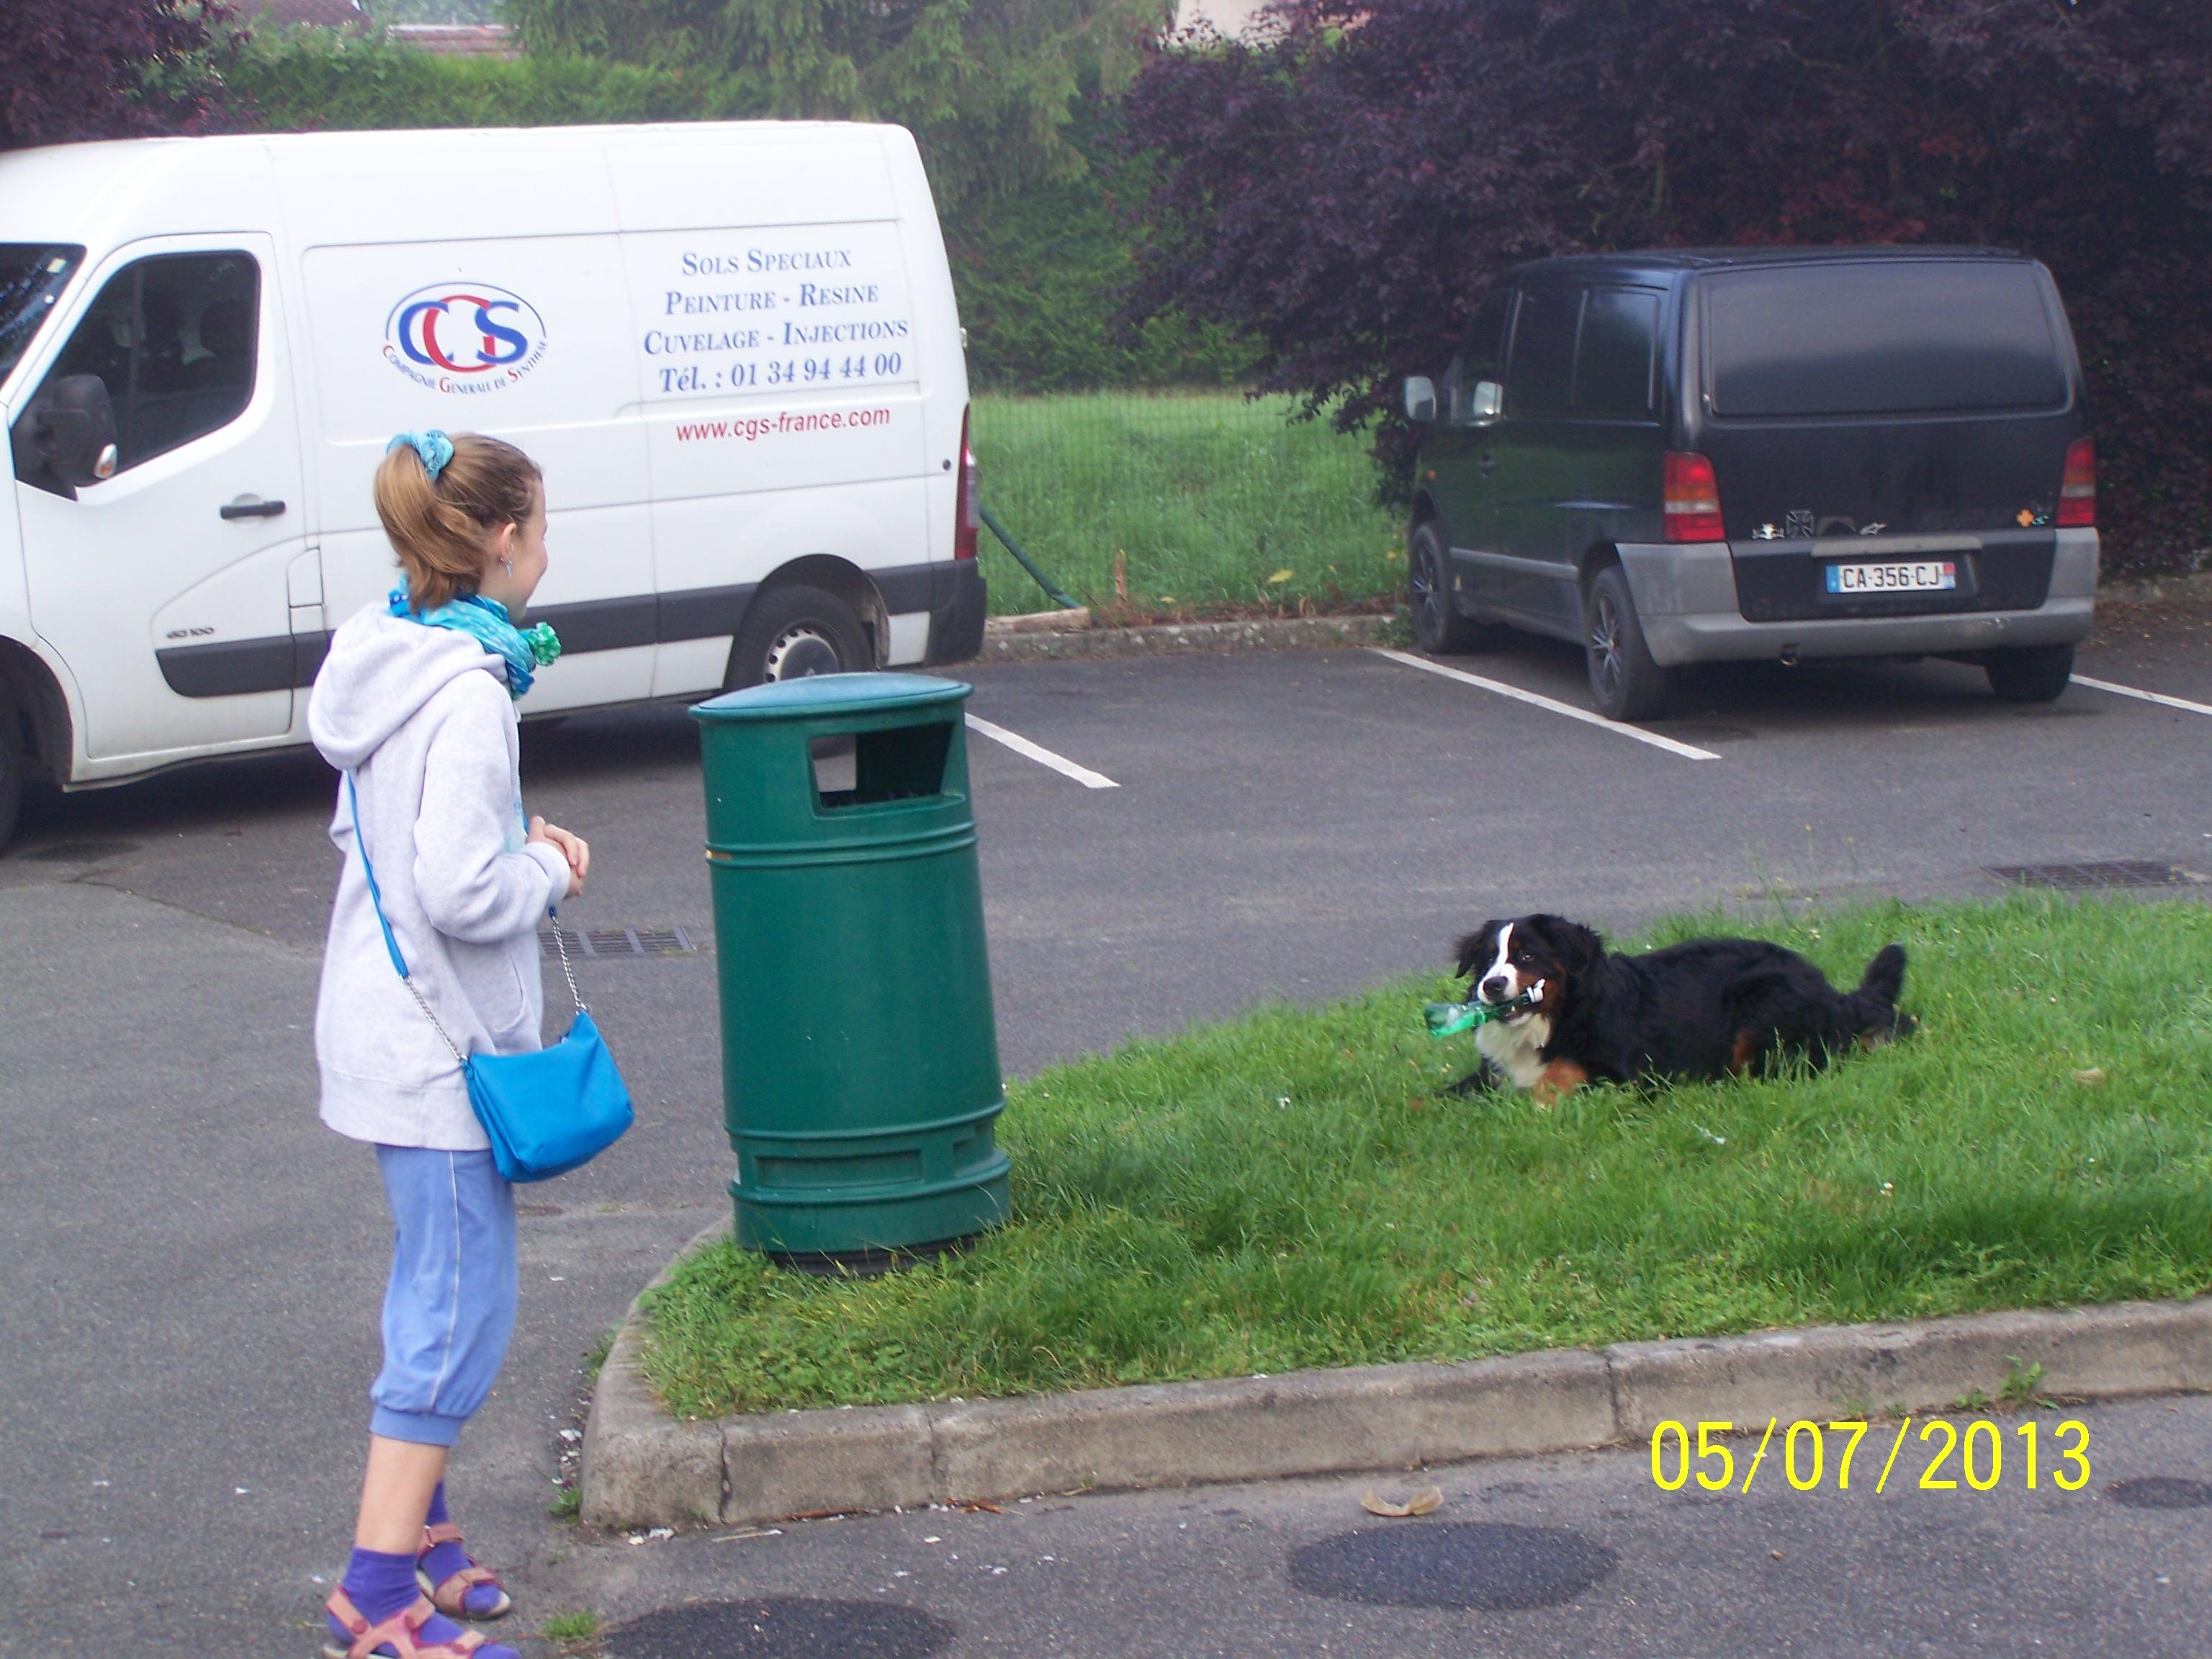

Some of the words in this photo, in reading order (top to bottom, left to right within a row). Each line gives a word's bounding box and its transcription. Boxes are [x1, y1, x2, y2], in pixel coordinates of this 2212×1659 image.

[682, 252, 739, 276] SOLS
[747, 249, 852, 273] SPECIAUX
[665, 291, 776, 315] PEINTURE
[799, 283, 879, 307] RESINE
[644, 330, 760, 355] CUVELAGE
[783, 320, 909, 346] INJECTIONS
[730, 364, 757, 387] 01
[768, 361, 795, 385] 34
[804, 358, 831, 382] 94
[840, 354, 866, 379] 44
[874, 351, 902, 376] 00
[675, 407, 891, 442] www.cgs-france.com
